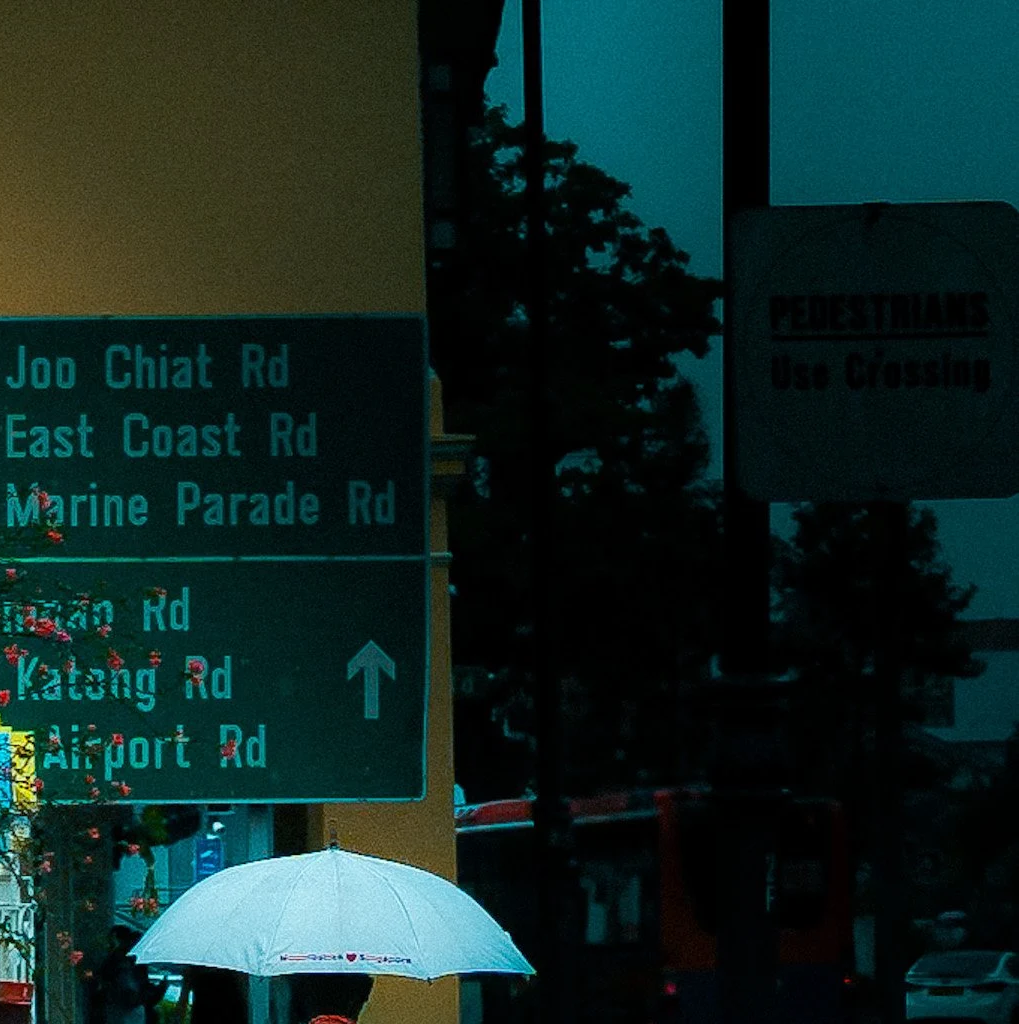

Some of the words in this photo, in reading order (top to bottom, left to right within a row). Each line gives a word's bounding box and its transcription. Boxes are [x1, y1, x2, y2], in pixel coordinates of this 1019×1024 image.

[770, 293, 989, 330] PEDESTRIANS
[5, 344, 77, 390] Joo
[105, 343, 214, 390] Chiat
[241, 342, 290, 388] Rd
[771, 354, 829, 390] Use
[846, 351, 991, 393] Crossing
[6, 413, 95, 459] East
[123, 412, 242, 458] Coast
[270, 411, 318, 457] Rd
[6, 482, 149, 528] Marine
[177, 481, 321, 527] Parade
[348, 479, 397, 526] Rd
[143, 586, 191, 632] Rd
[17, 654, 156, 712] Katong
[185, 655, 232, 699] Rd
[43, 724, 191, 781] Airport
[220, 723, 267, 768] Rd
